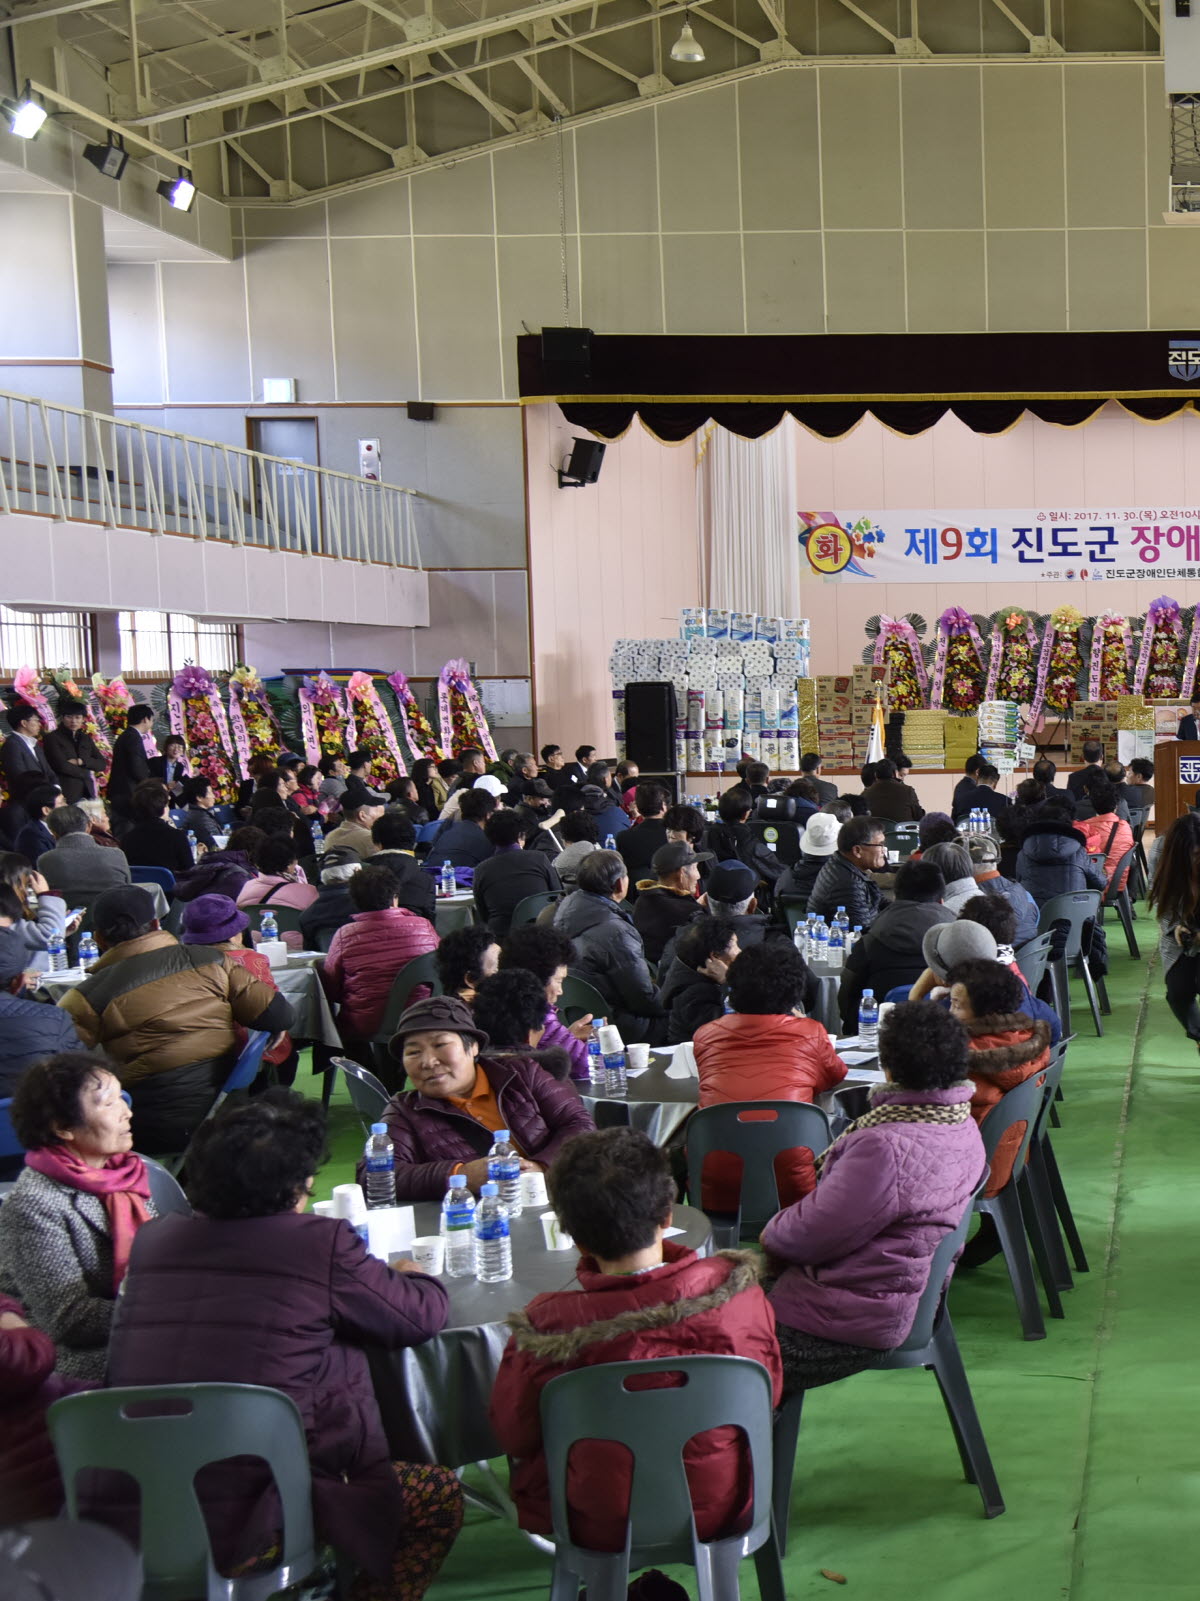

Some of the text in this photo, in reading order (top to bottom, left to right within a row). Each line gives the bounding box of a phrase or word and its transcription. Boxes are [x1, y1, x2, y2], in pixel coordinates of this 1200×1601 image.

[1049, 511, 1071, 522] 일시:
[1074, 511, 1102, 521] 2017.
[1106, 512, 1120, 520] 11.
[1159, 510, 1200, 520] 오전10시
[814, 532, 844, 566] 화
[904, 527, 998, 565] 제9회
[1011, 526, 1119, 563] 진도군
